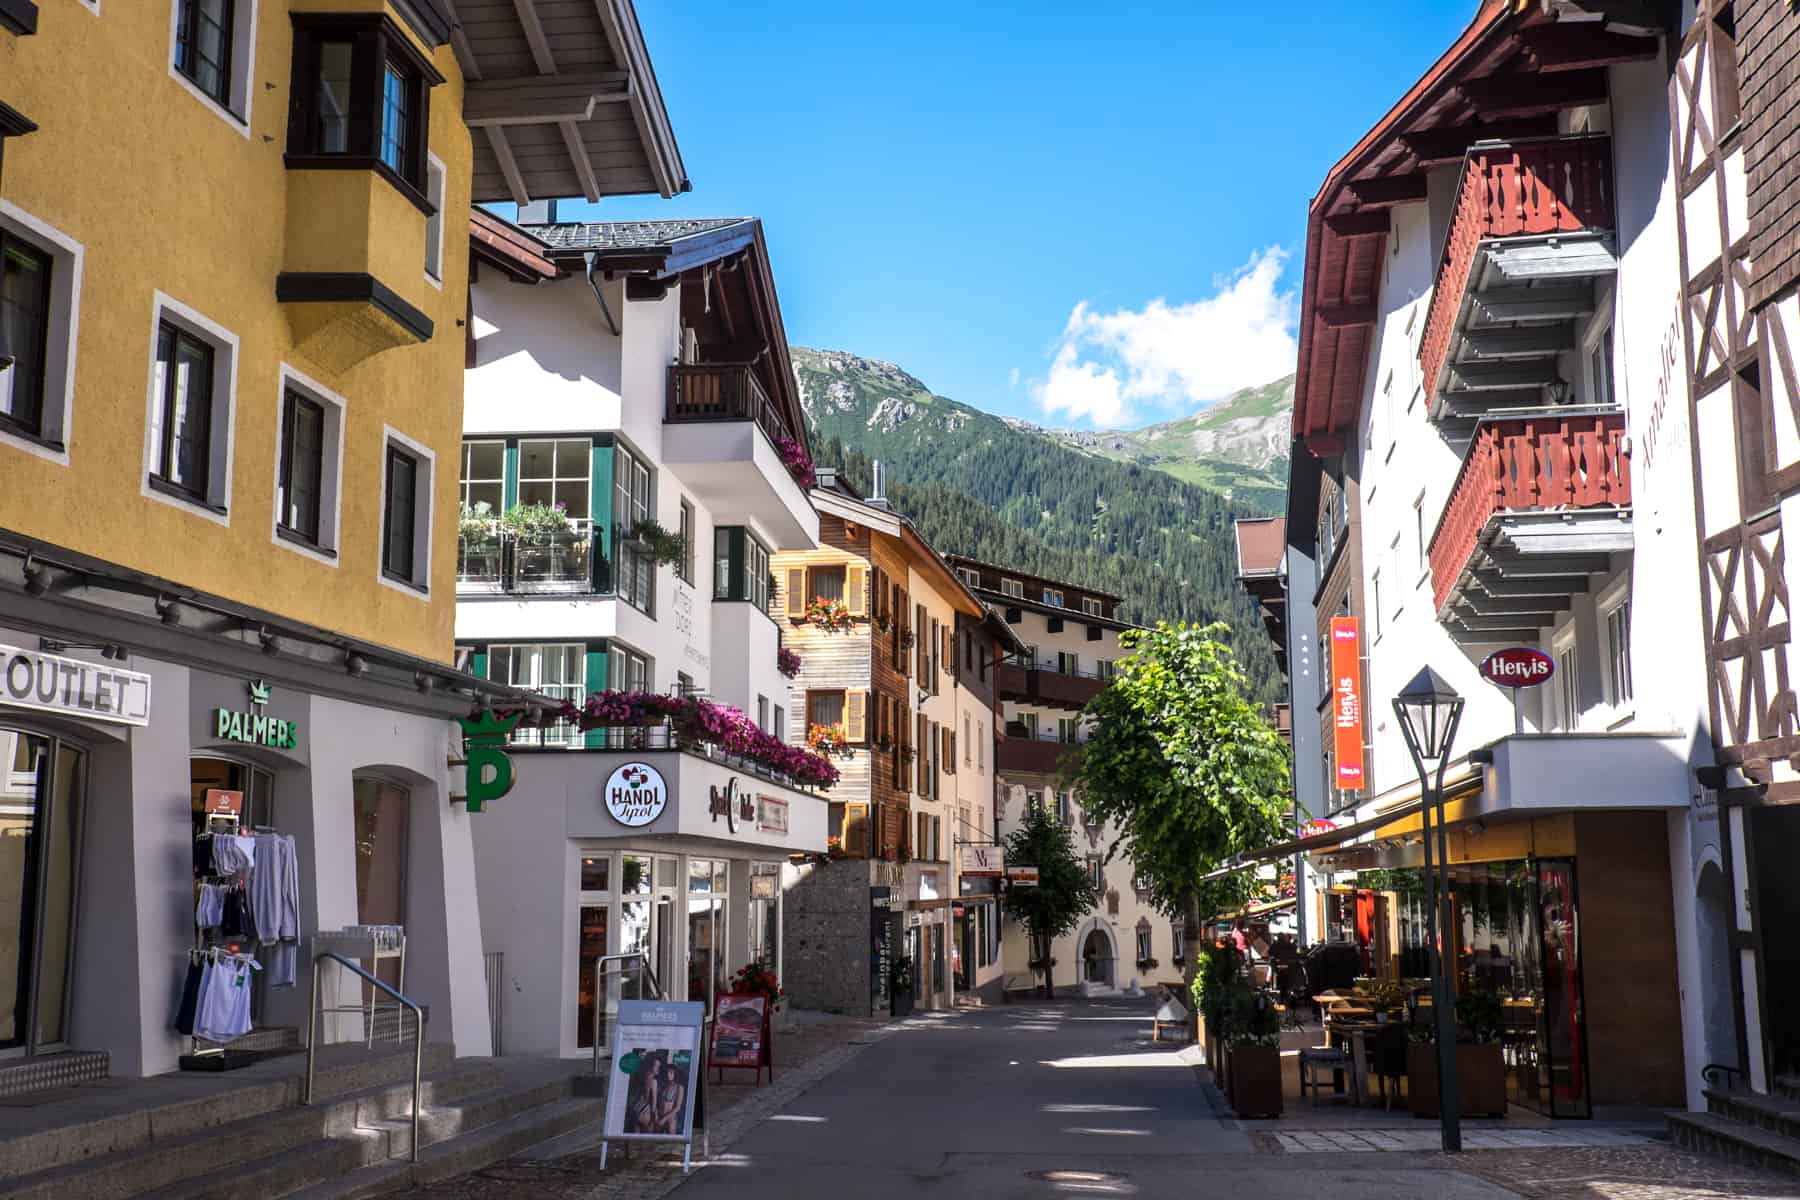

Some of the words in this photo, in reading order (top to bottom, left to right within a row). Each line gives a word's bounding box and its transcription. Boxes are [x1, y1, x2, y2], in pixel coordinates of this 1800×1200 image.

[1491, 656, 1549, 679] Hervis
[1337, 677, 1357, 728] Hervis
[217, 707, 297, 749] PALMERS
[612, 786, 661, 806] HANDL
[614, 800, 654, 823] Tyrol
